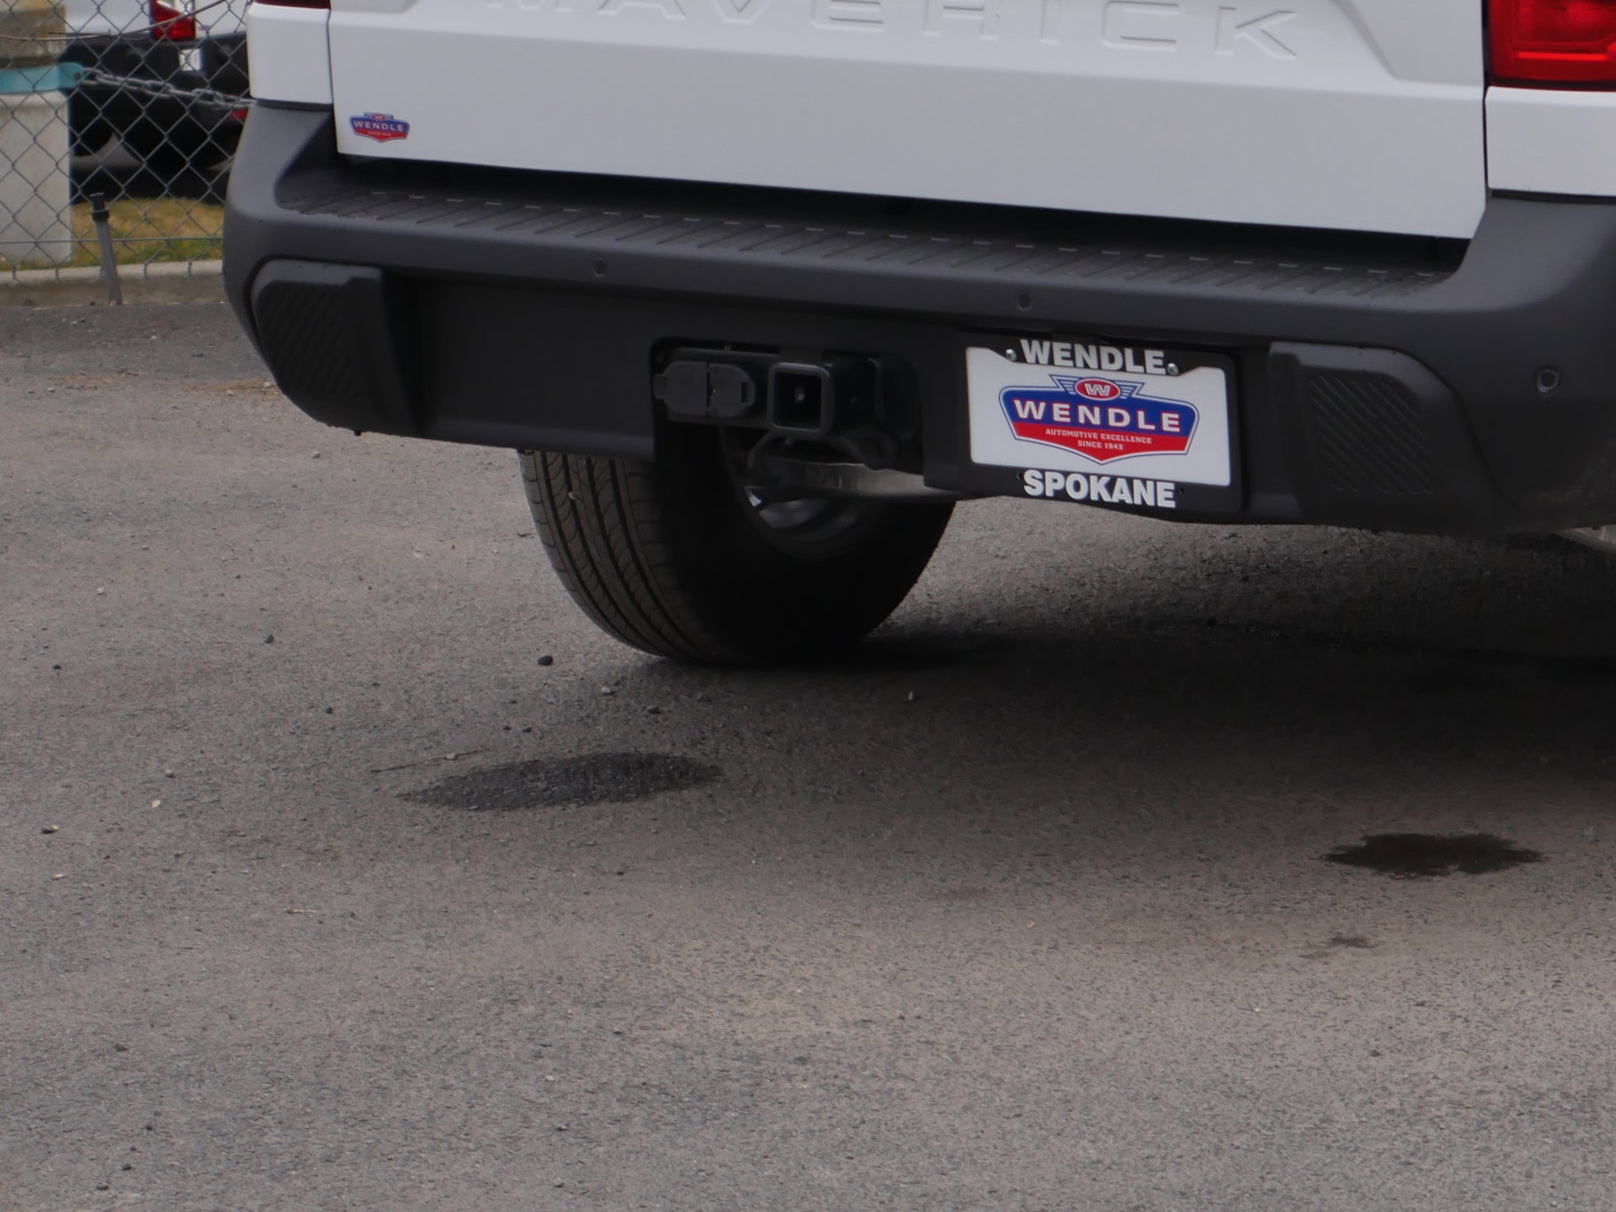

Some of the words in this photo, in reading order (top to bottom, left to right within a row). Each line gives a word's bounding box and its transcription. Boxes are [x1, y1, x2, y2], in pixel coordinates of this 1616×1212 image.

[353, 119, 404, 132] WENDLE
[1019, 338, 1167, 375] WENDLE
[1014, 400, 1180, 432] WENDLE
[1045, 428, 1098, 439] AUTOMOTIVE
[1100, 432, 1152, 444] EXCELLENCE
[1077, 440, 1102, 448] SINCE
[1023, 469, 1177, 508] SPOKANE
